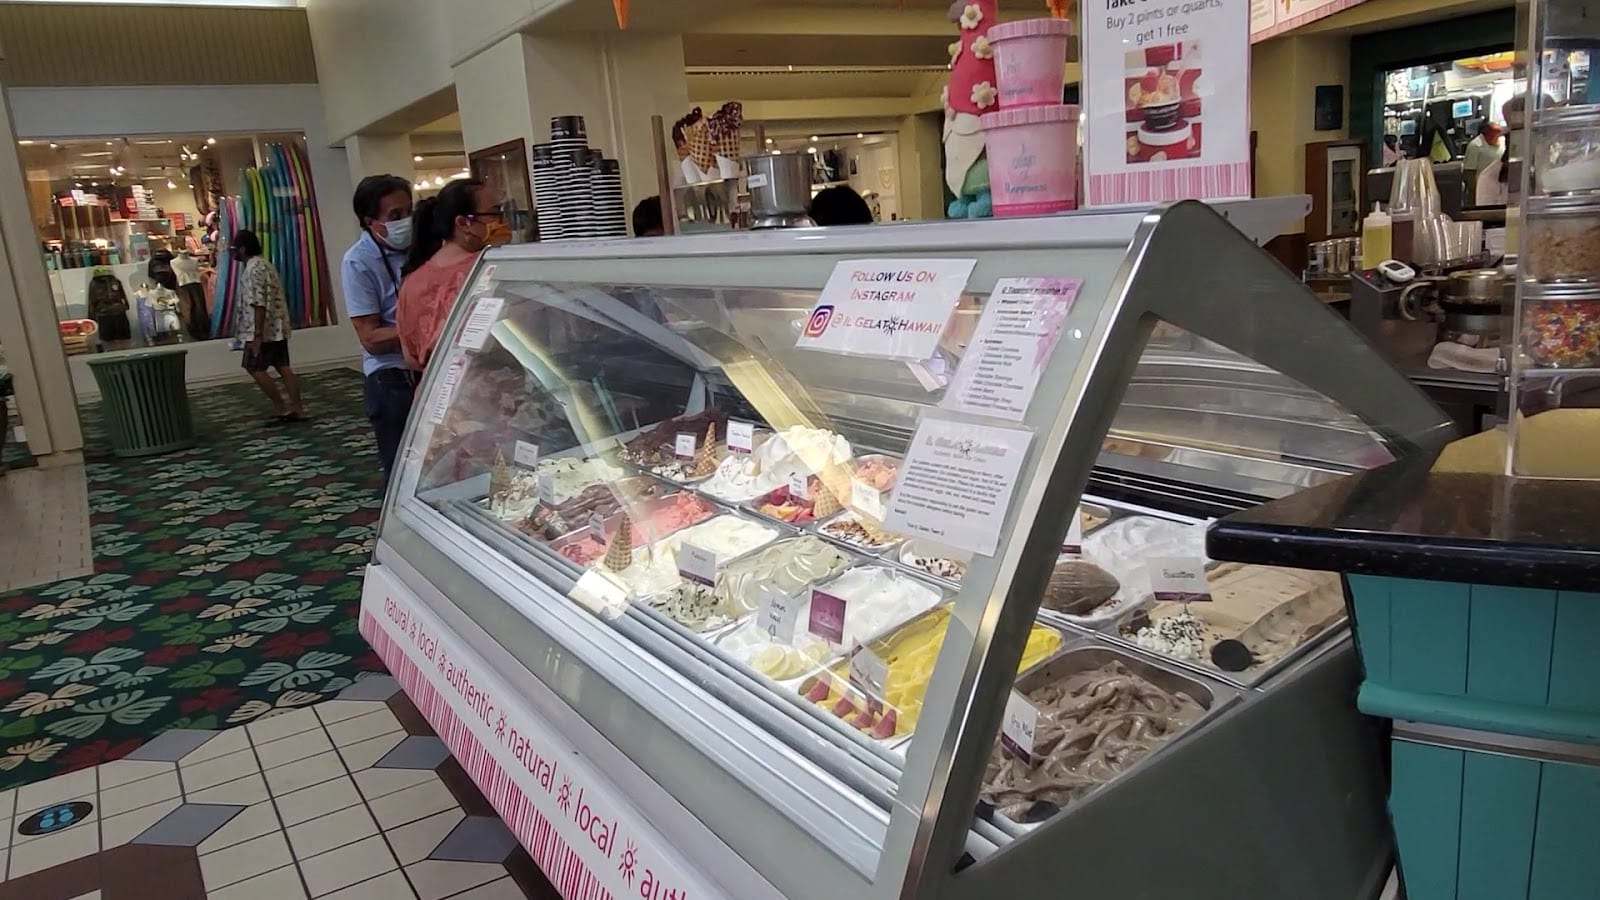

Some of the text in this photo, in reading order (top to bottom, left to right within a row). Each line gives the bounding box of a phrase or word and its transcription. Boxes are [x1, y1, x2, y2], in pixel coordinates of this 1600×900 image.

[1106, 16, 1127, 30] Buy
[1128, 12, 1135, 25] 2
[1137, 8, 1165, 26] pints
[1166, 6, 1179, 17] or
[1136, 23, 1189, 46] get 1 free
[850, 270, 894, 283] FOLLOW
[915, 270, 937, 283] ON
[850, 288, 916, 302] INSTAGRAM
[384, 597, 411, 633] natural
[416, 621, 439, 664] local
[446, 661, 495, 728] authentic
[508, 727, 558, 795] natural
[574, 787, 618, 859] local
